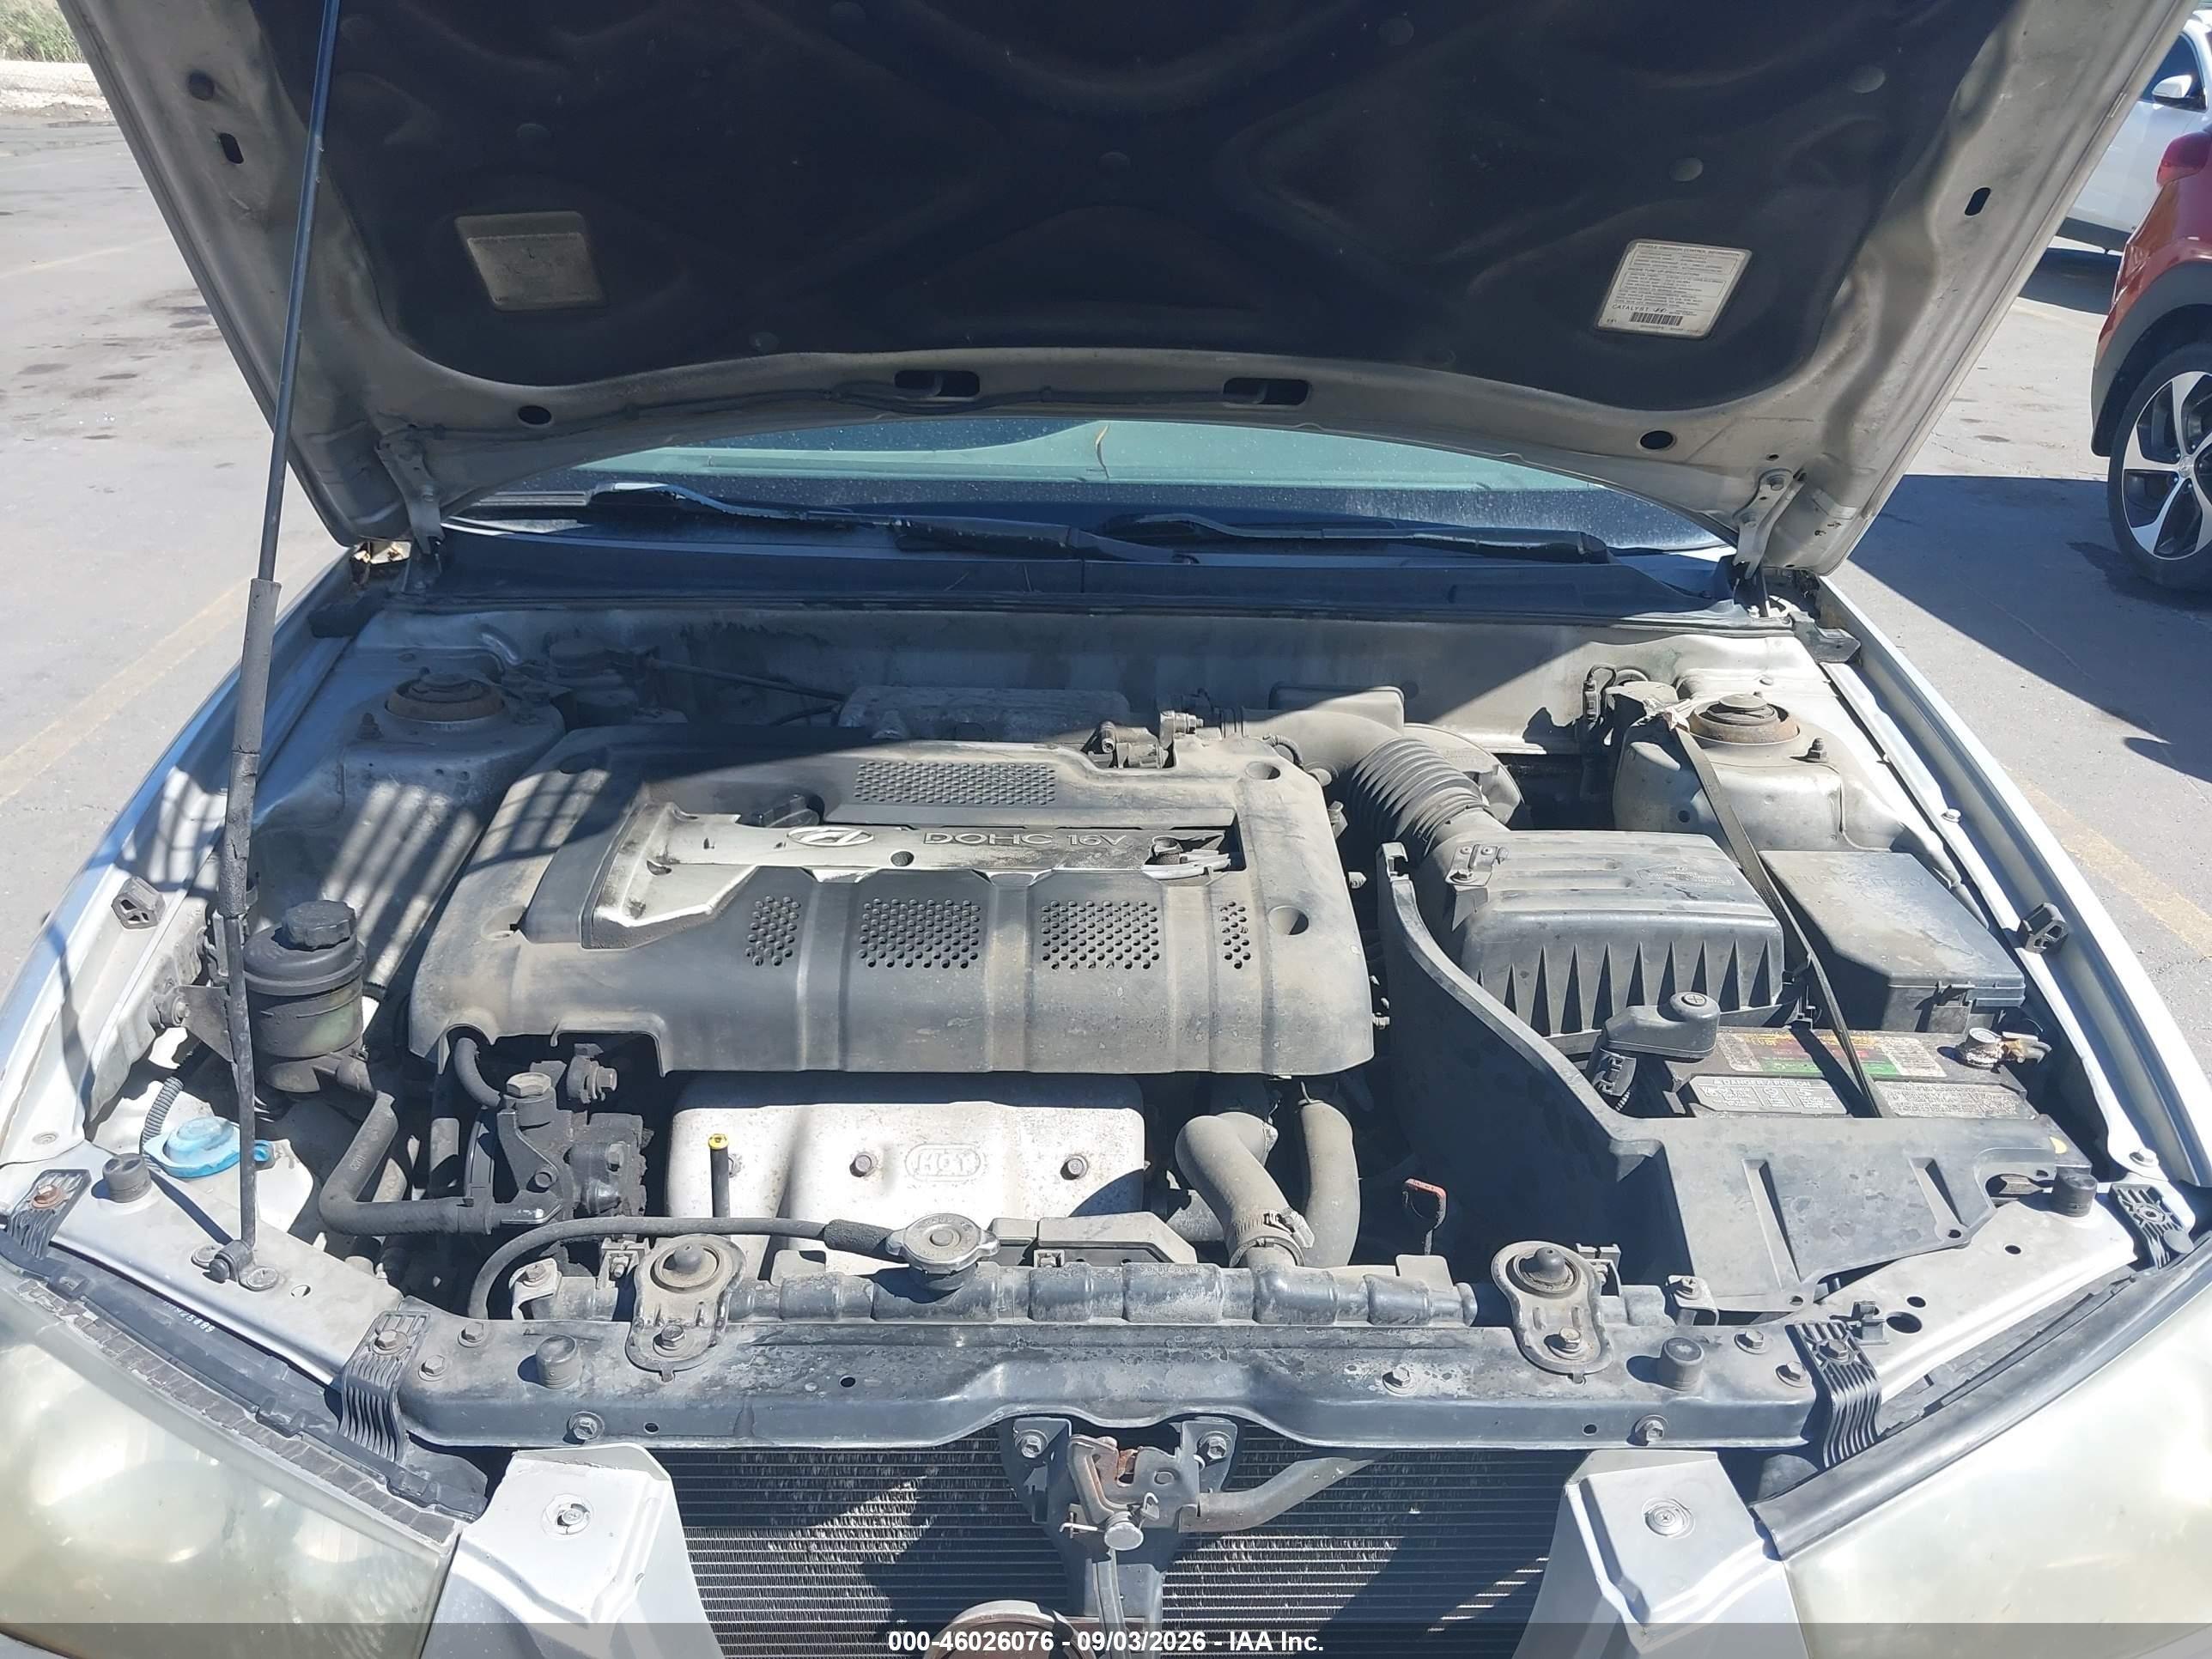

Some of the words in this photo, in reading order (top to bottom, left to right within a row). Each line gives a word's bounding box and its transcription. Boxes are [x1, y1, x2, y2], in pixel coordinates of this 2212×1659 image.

[1612, 303, 1649, 313] CATALYST
[924, 831, 1055, 847] DOHC
[1066, 833, 1127, 847] 16V
